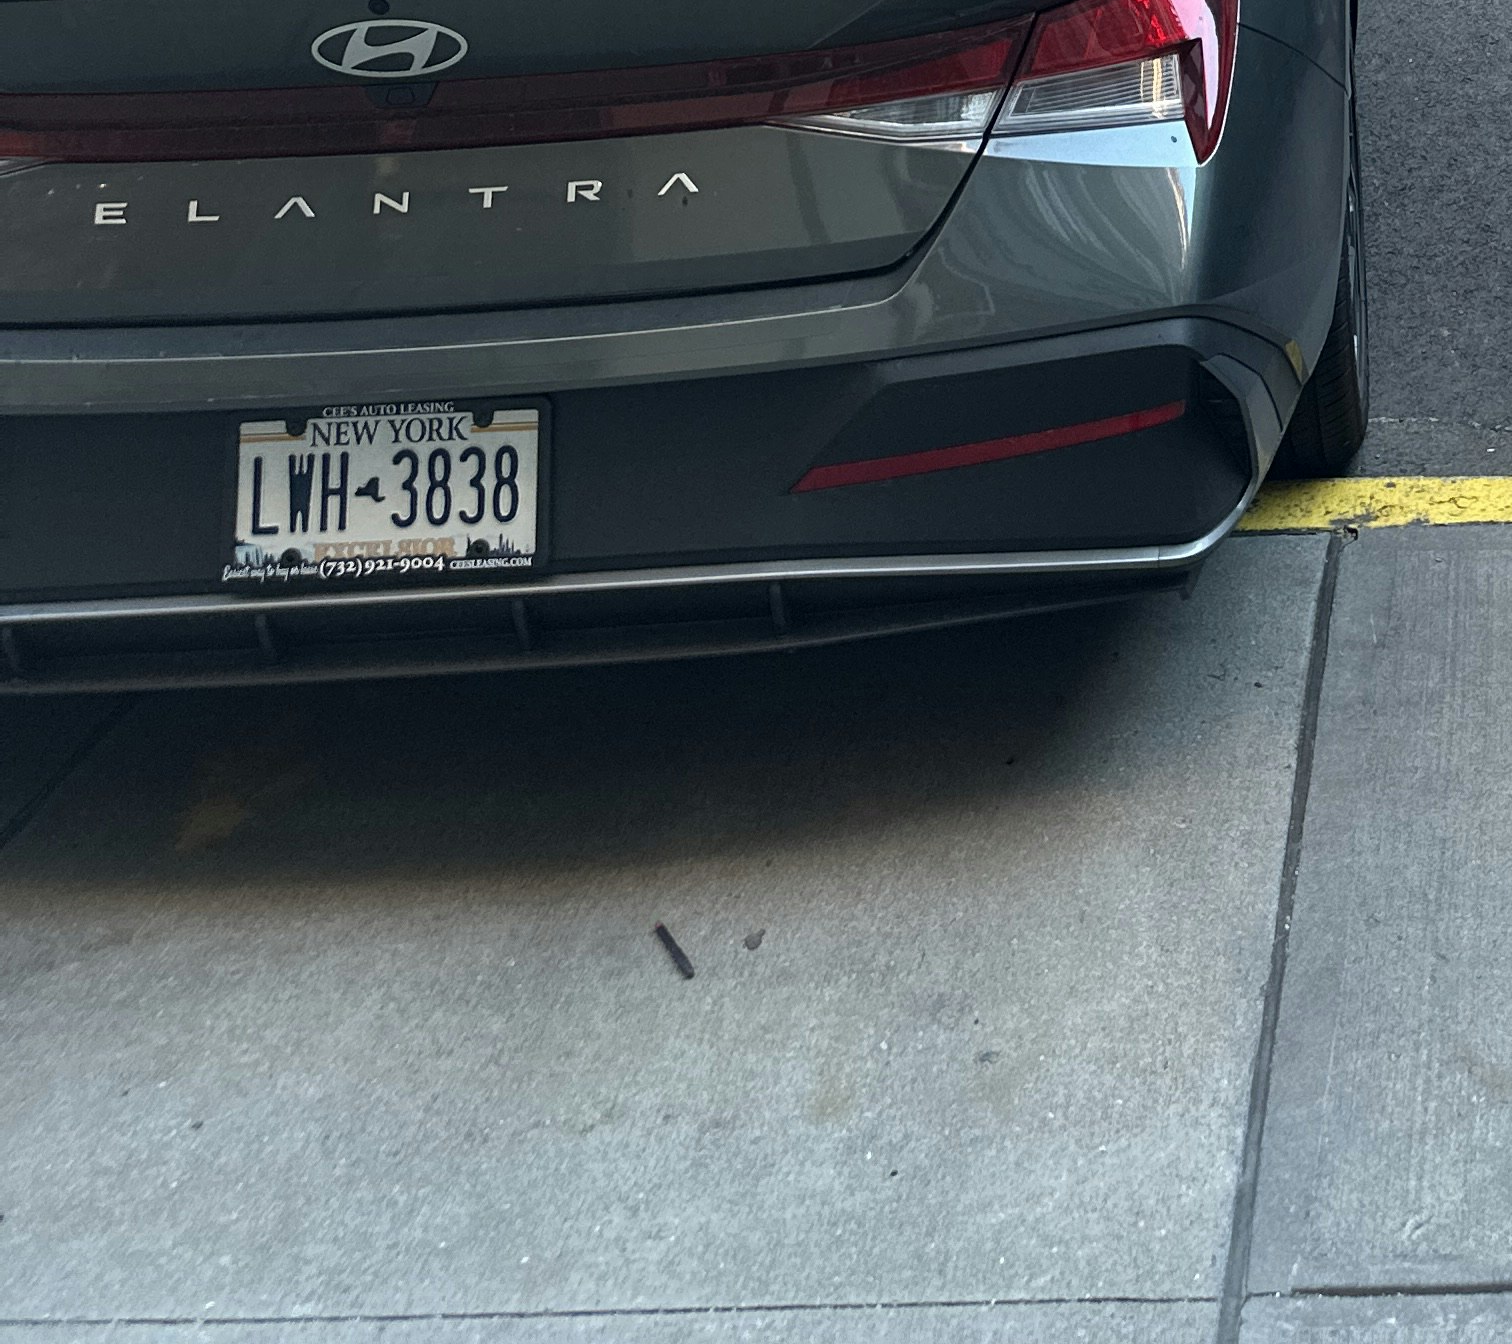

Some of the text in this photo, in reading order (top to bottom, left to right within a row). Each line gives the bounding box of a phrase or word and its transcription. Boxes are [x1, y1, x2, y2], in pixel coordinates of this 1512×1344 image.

[94, 172, 699, 224] ELANTRA
[322, 401, 455, 418] CEE'S AUTO LEASING
[310, 415, 468, 448] NEW YORK
[252, 444, 519, 535] LWH 3838
